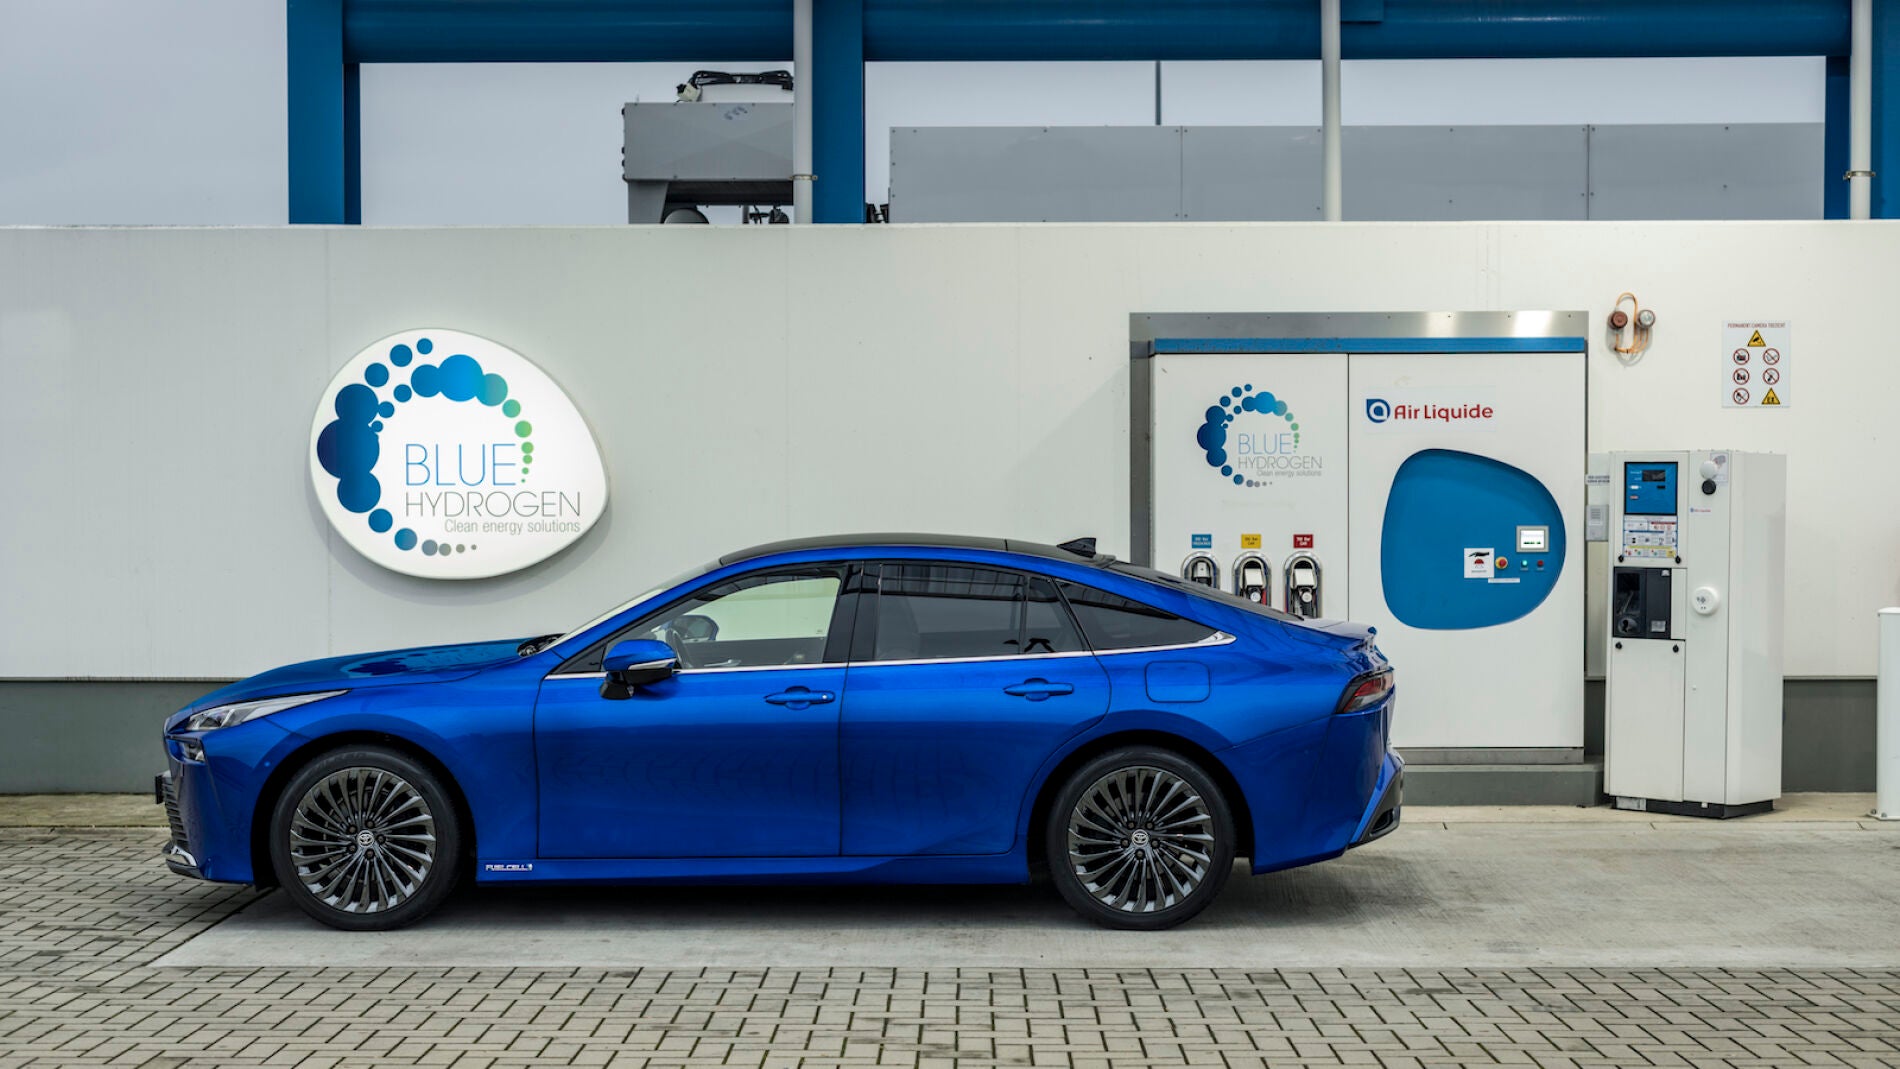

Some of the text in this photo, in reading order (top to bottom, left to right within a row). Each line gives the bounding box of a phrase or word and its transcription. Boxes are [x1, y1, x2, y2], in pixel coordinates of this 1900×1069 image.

[1394, 404, 1494, 422] Air Liquide
[1238, 433, 1292, 455] BLUE
[405, 444, 517, 486] BLUE
[1238, 456, 1323, 469] HYDROGEN
[405, 491, 580, 517] HYDROGEN
[444, 519, 581, 536] Clean energy solutions
